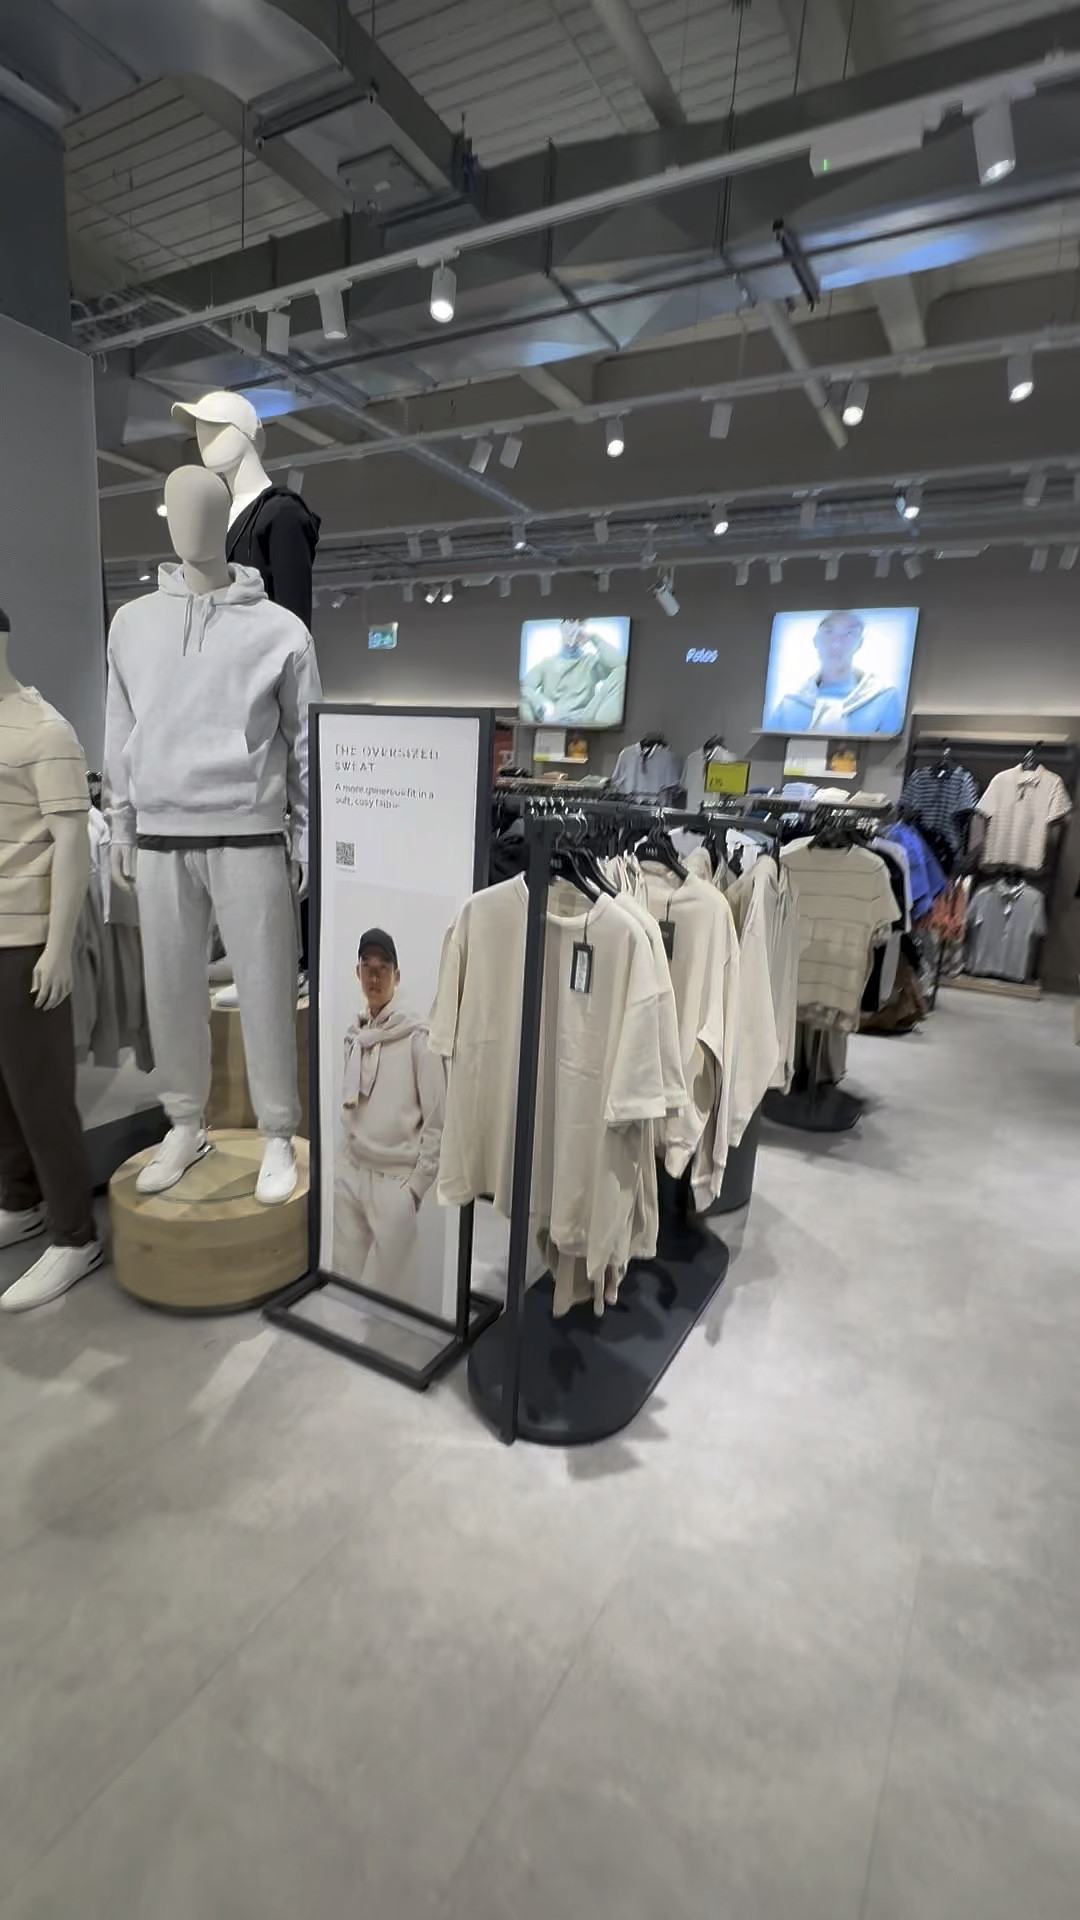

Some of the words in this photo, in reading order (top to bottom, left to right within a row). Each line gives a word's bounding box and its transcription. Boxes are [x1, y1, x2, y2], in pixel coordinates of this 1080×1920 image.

[335, 744, 356, 756] THE
[335, 783, 341, 792] A
[343, 785, 363, 794] more
[407, 787, 416, 798] fit
[418, 788, 427, 799] in
[354, 799, 374, 809] cosy
